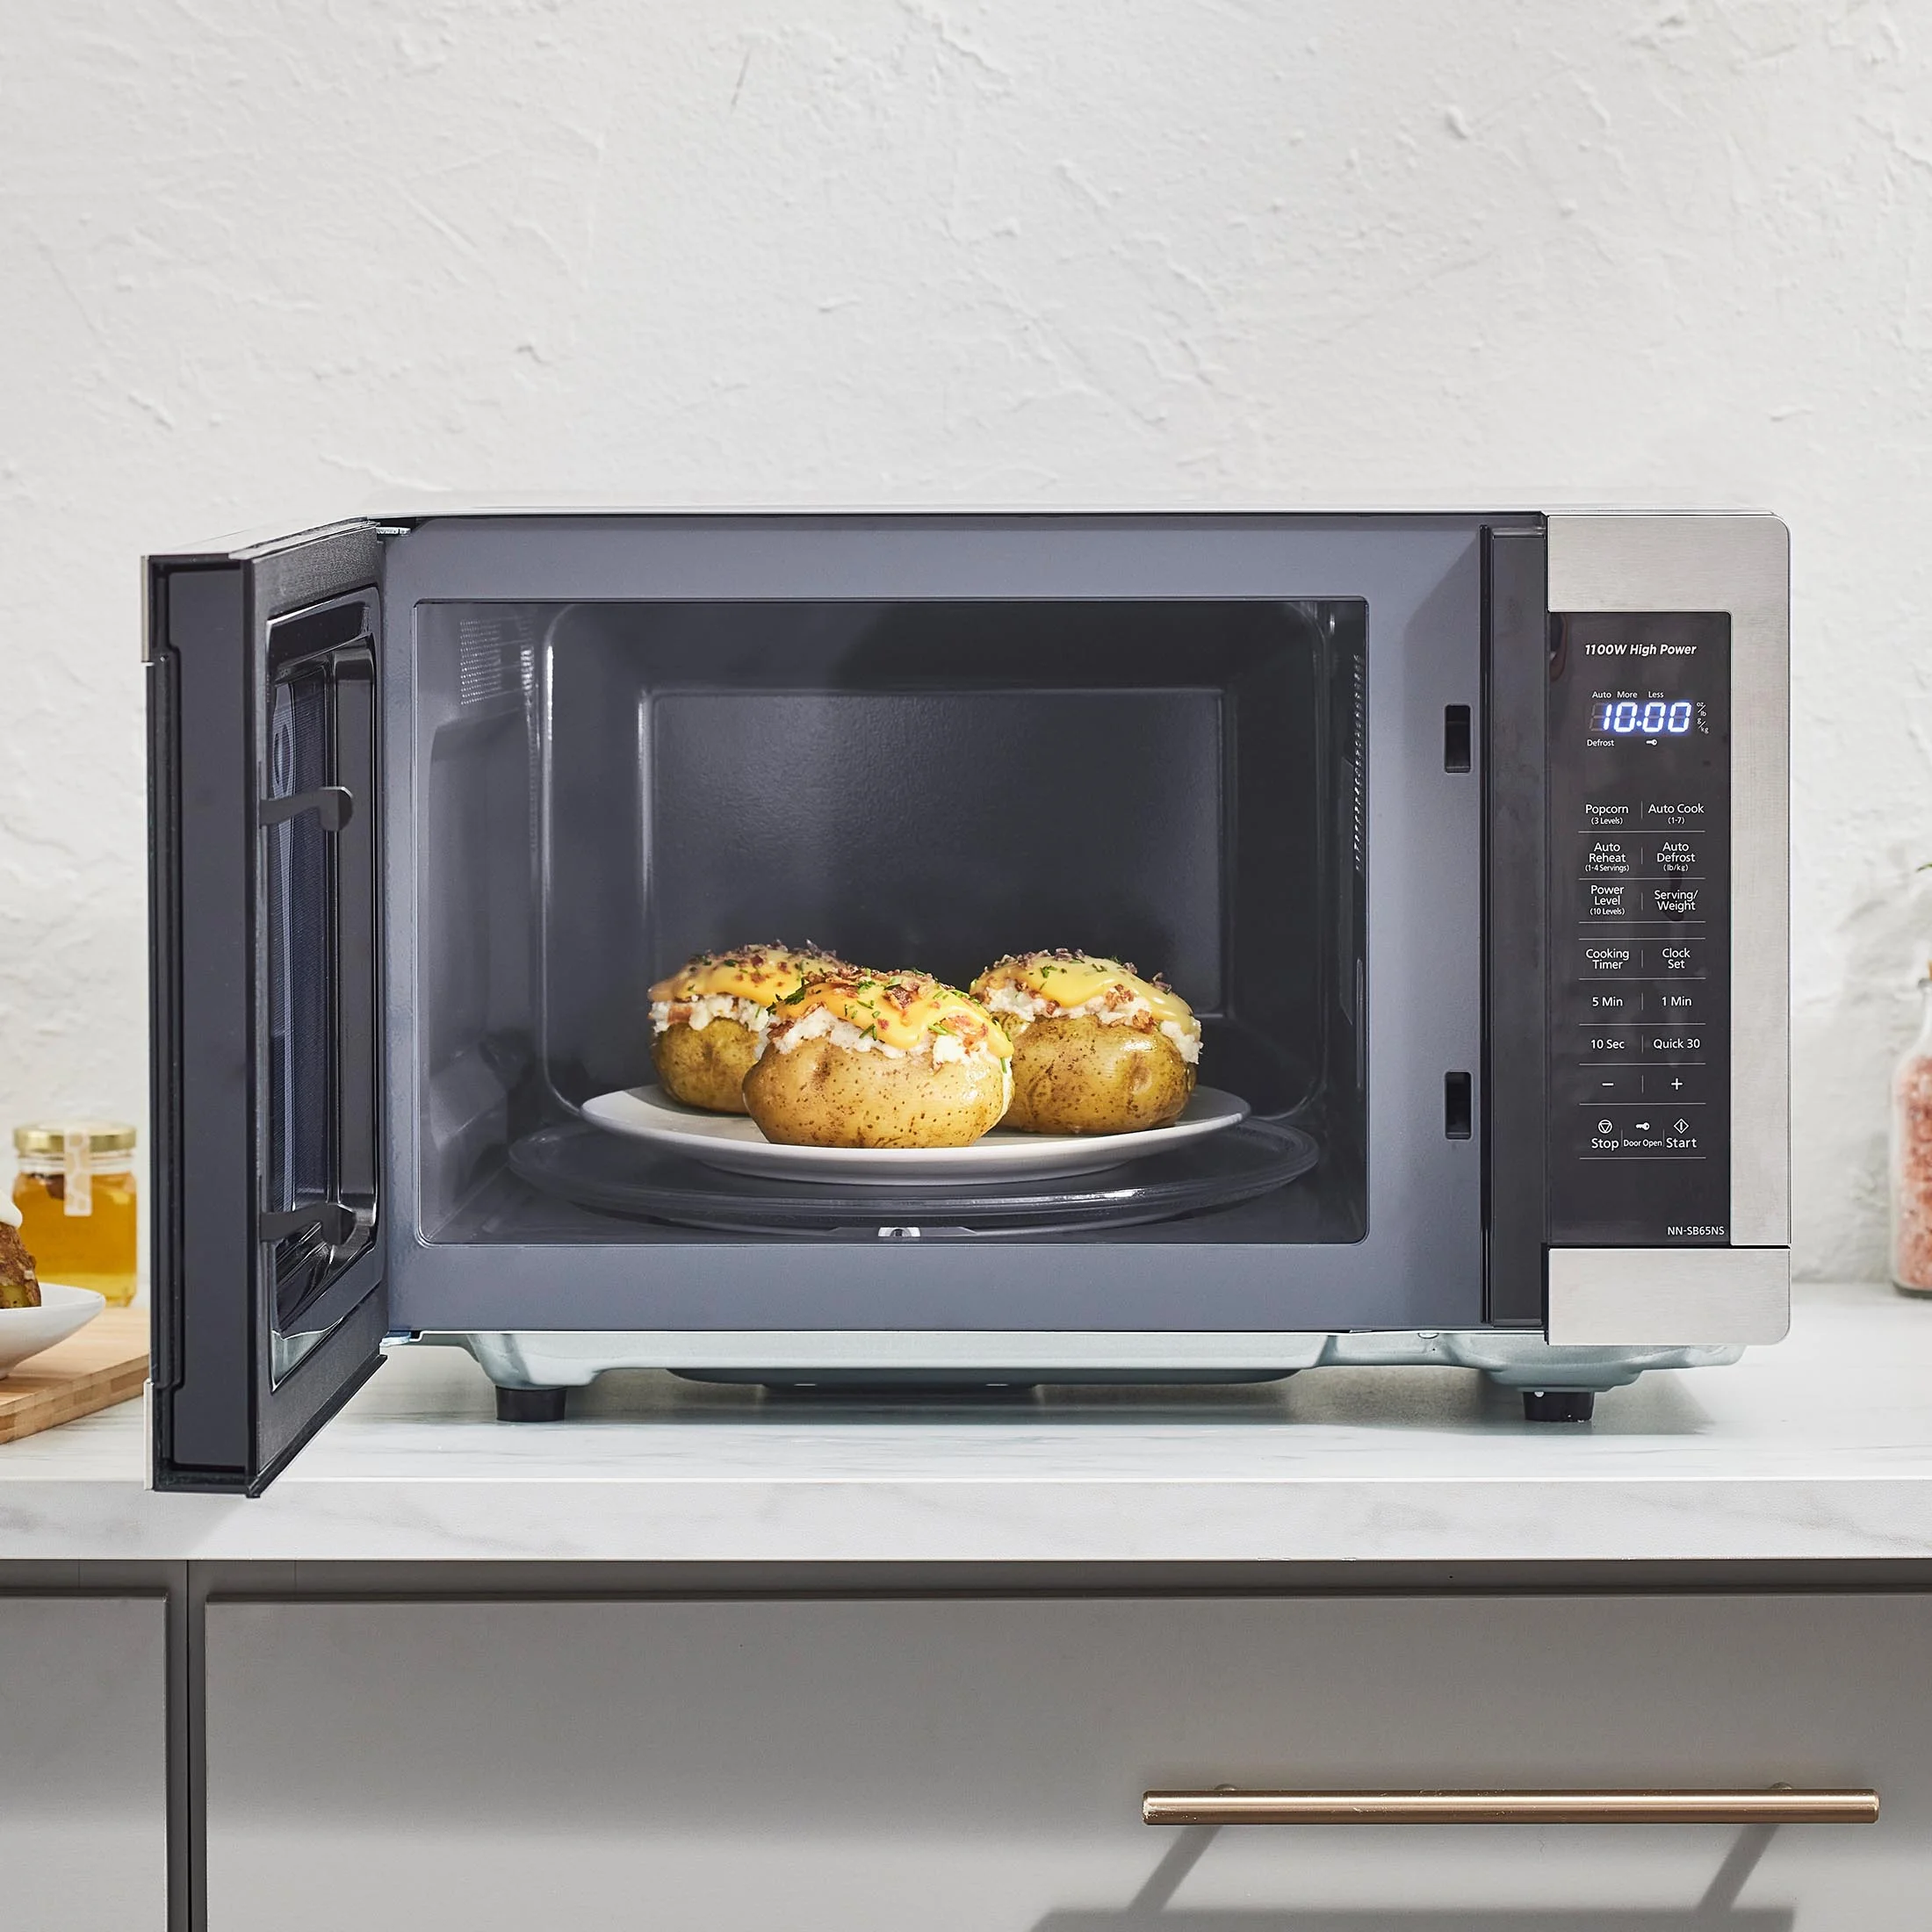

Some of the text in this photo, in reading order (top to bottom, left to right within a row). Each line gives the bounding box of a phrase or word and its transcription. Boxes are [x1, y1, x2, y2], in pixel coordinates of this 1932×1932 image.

[1585, 644, 1698, 657] 1100W High Power
[1591, 690, 1664, 699] Auto More Less
[1586, 739, 1615, 747] Defrost
[1585, 804, 1629, 816] Popcorn
[1647, 803, 1705, 814] Auto Cook
[1590, 817, 1624, 825] (3 Levels)
[1593, 842, 1621, 853] Auto
[1662, 841, 1690, 852] Auto
[1589, 853, 1626, 863] Reheat
[1656, 853, 1696, 862] Defrost
[1584, 864, 1630, 874] (1-4 Servings)
[1662, 864, 1689, 873] (lb/kg)
[1590, 884, 1625, 895] Power
[1654, 889, 1698, 900] Serving/
[1594, 895, 1621, 905] Level
[1590, 907, 1626, 916] (10 Levels)
[1657, 900, 1697, 913] Weight
[1585, 948, 1630, 961] Cooking
[1662, 948, 1691, 958] Clock
[1592, 959, 1624, 970] Timer
[1668, 959, 1685, 970] Set
[1592, 996, 1624, 1007] 5 Min
[1662, 995, 1692, 1006] 1 Min
[1590, 1039, 1626, 1049] 10 Sec
[1653, 1038, 1701, 1050] Quick 30
[1591, 1137, 1619, 1151] Stop
[1623, 1138, 1662, 1149] Door Open
[1666, 1137, 1698, 1149] Start
[1667, 1225, 1725, 1236] NN-SB65NS
